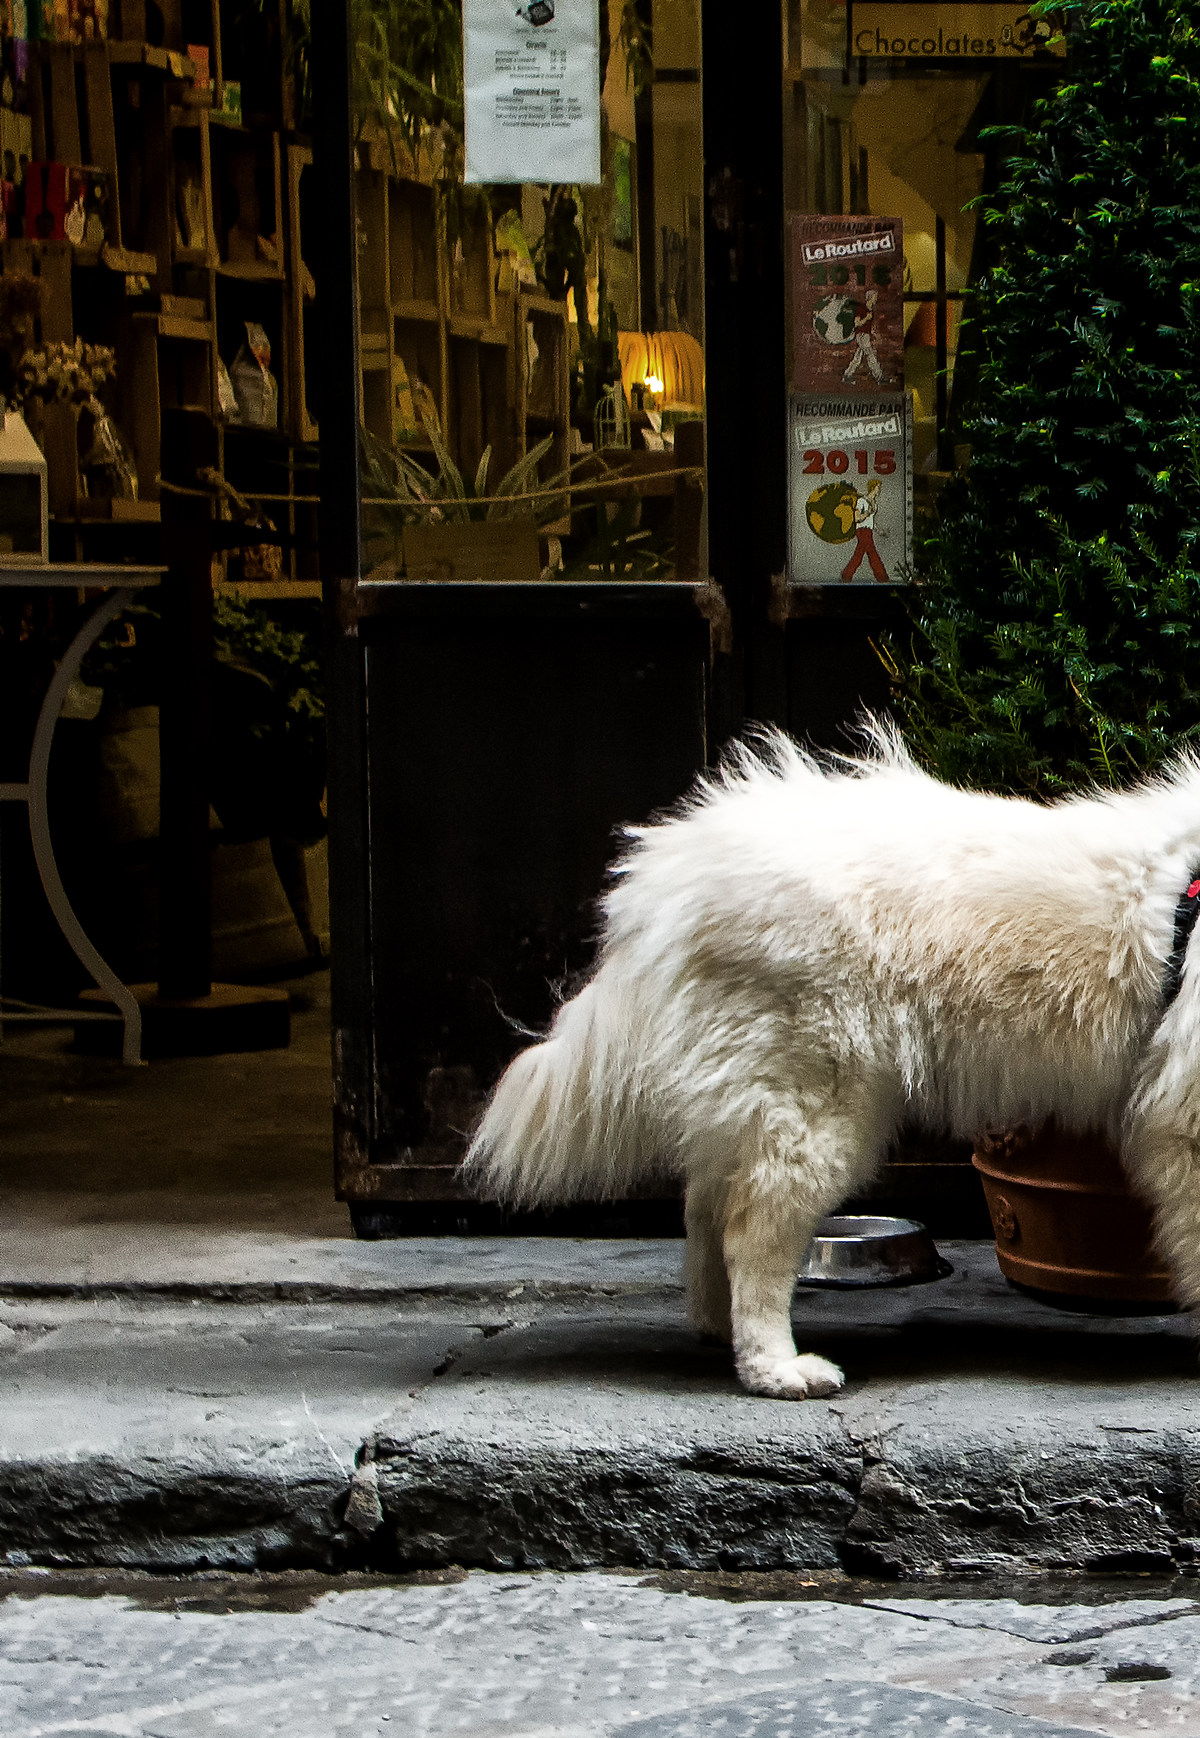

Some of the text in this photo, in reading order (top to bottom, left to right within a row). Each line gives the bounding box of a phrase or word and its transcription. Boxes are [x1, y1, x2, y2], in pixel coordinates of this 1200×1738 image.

[855, 27, 997, 54] Chocolates
[809, 264, 892, 287] 2016
[878, 403, 902, 416] PAR
[802, 449, 897, 475] 2015
